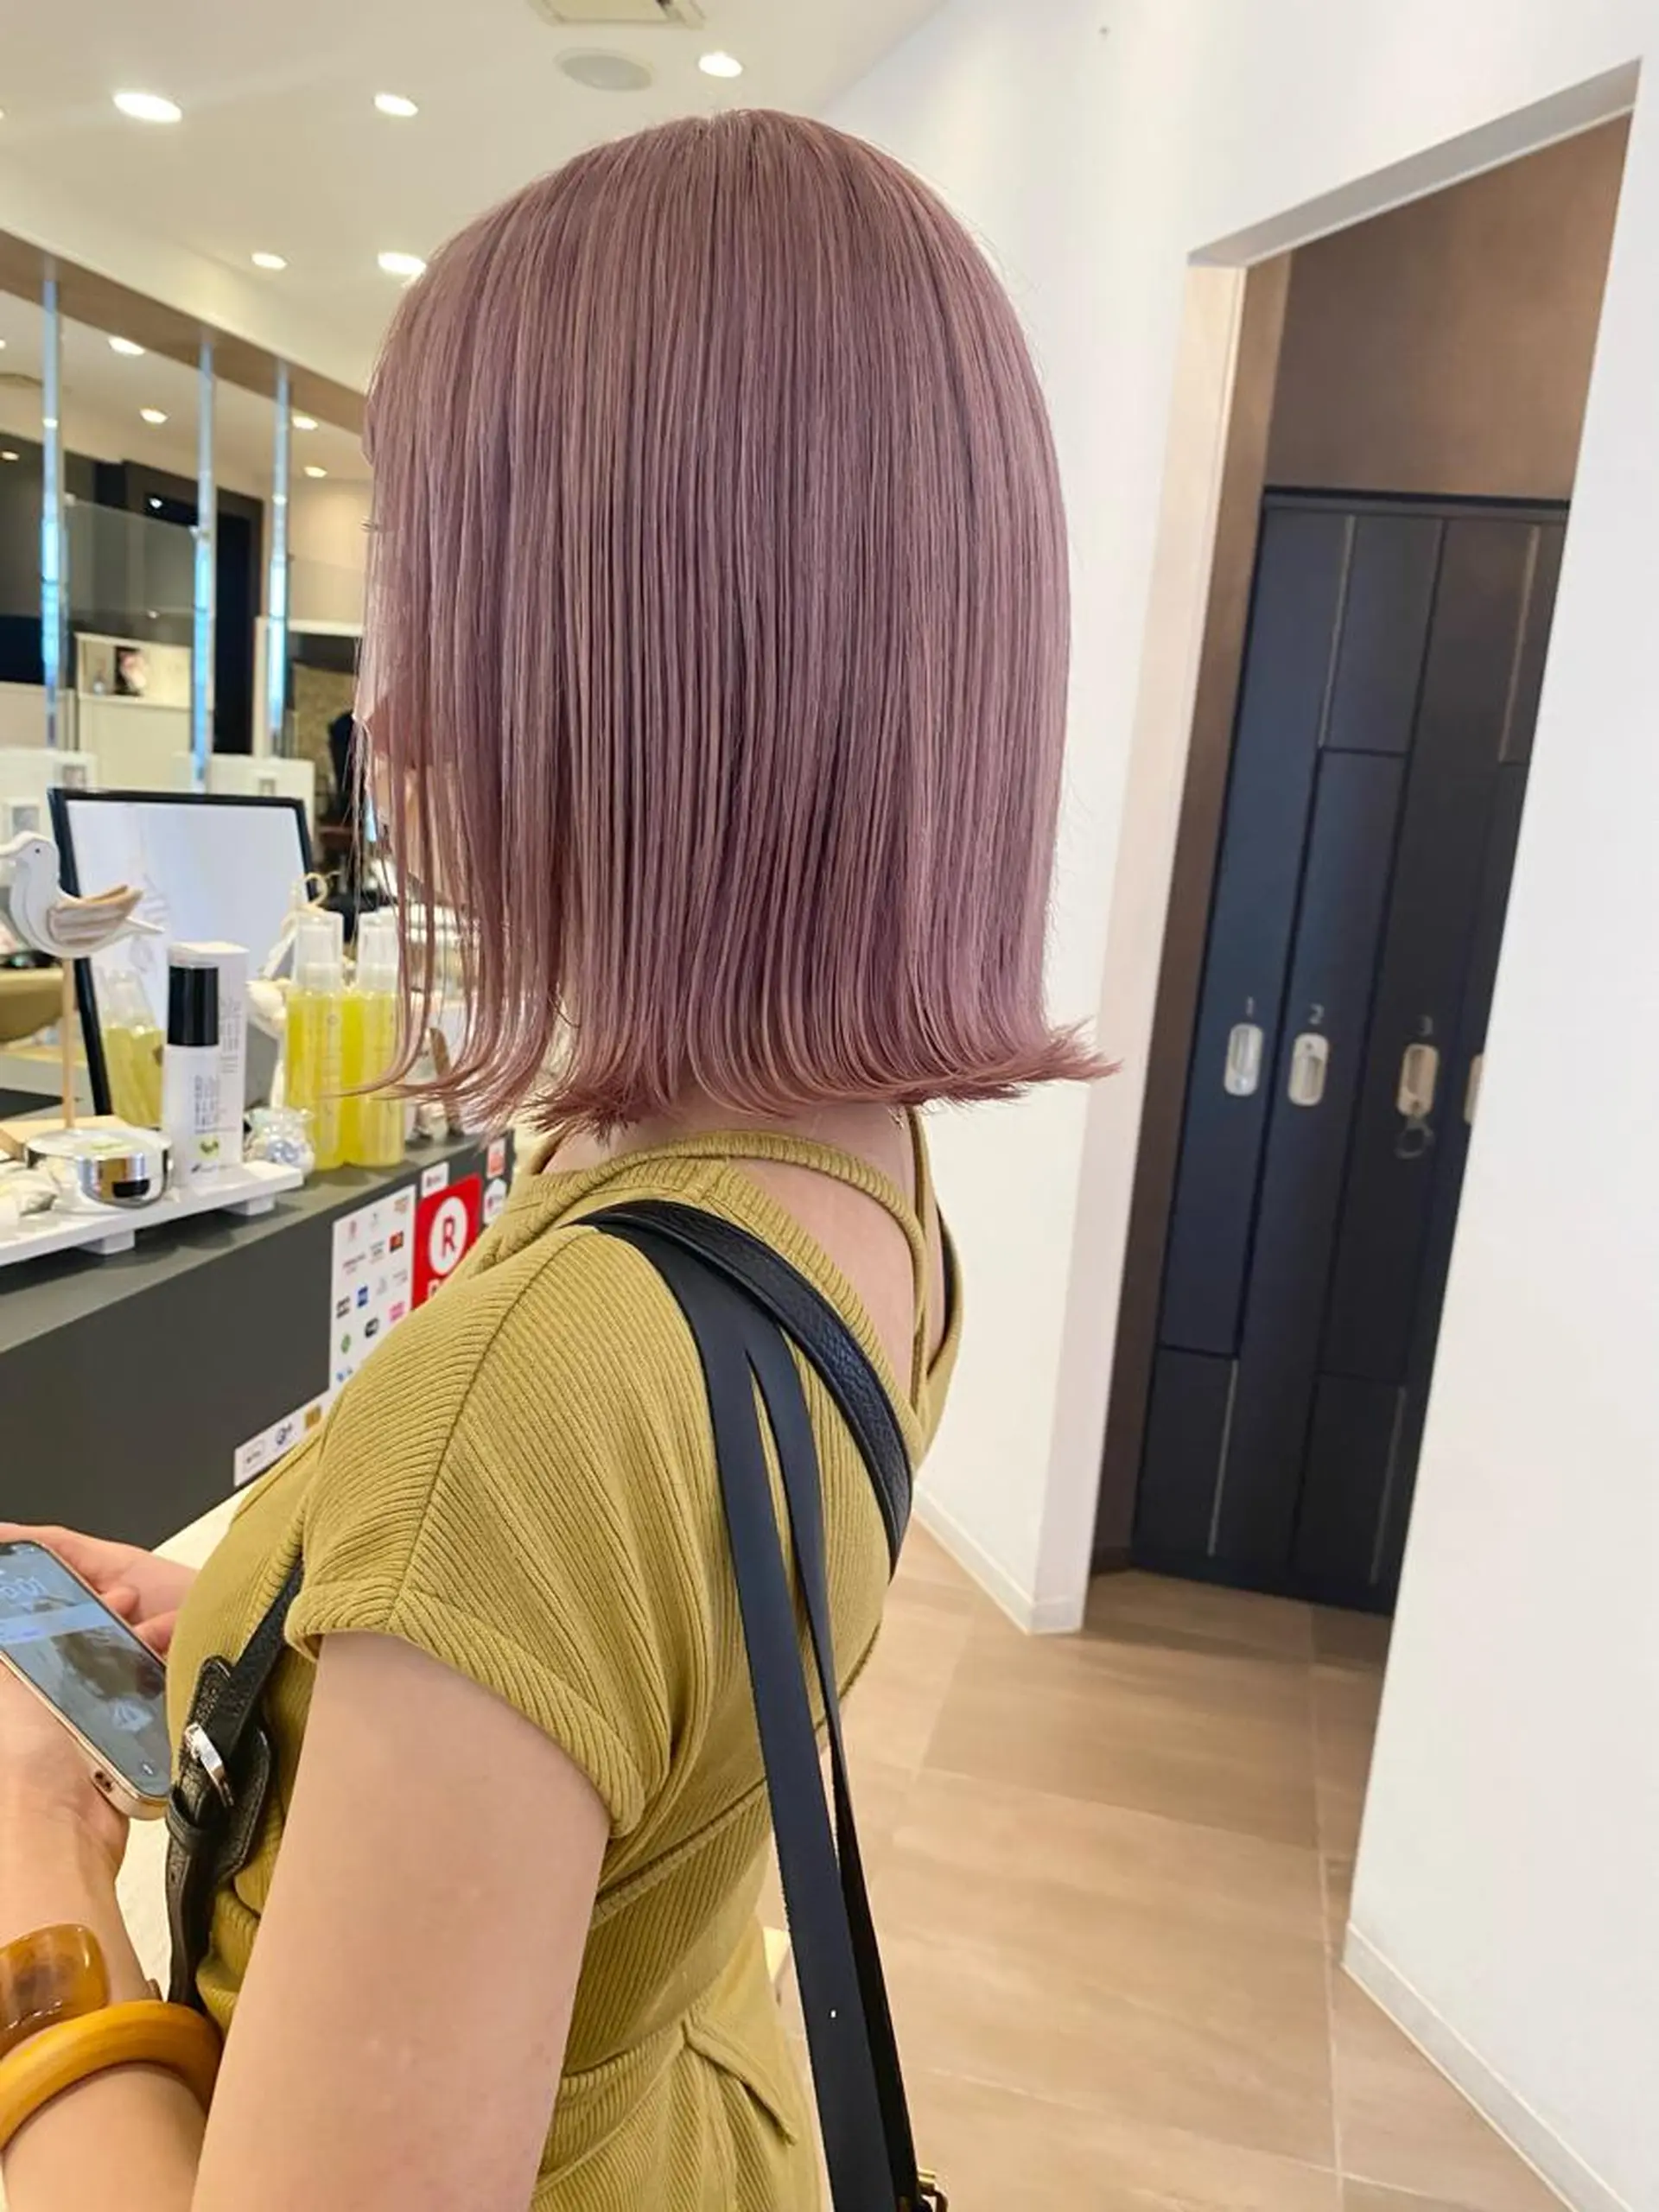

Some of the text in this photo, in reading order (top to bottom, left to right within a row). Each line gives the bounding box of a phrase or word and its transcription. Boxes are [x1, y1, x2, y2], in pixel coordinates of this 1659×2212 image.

[1246, 996, 1255, 1017] 1
[1309, 1003, 1325, 1025] 2
[1420, 1014, 1433, 1035] 3
[442, 1216, 457, 1258] R
